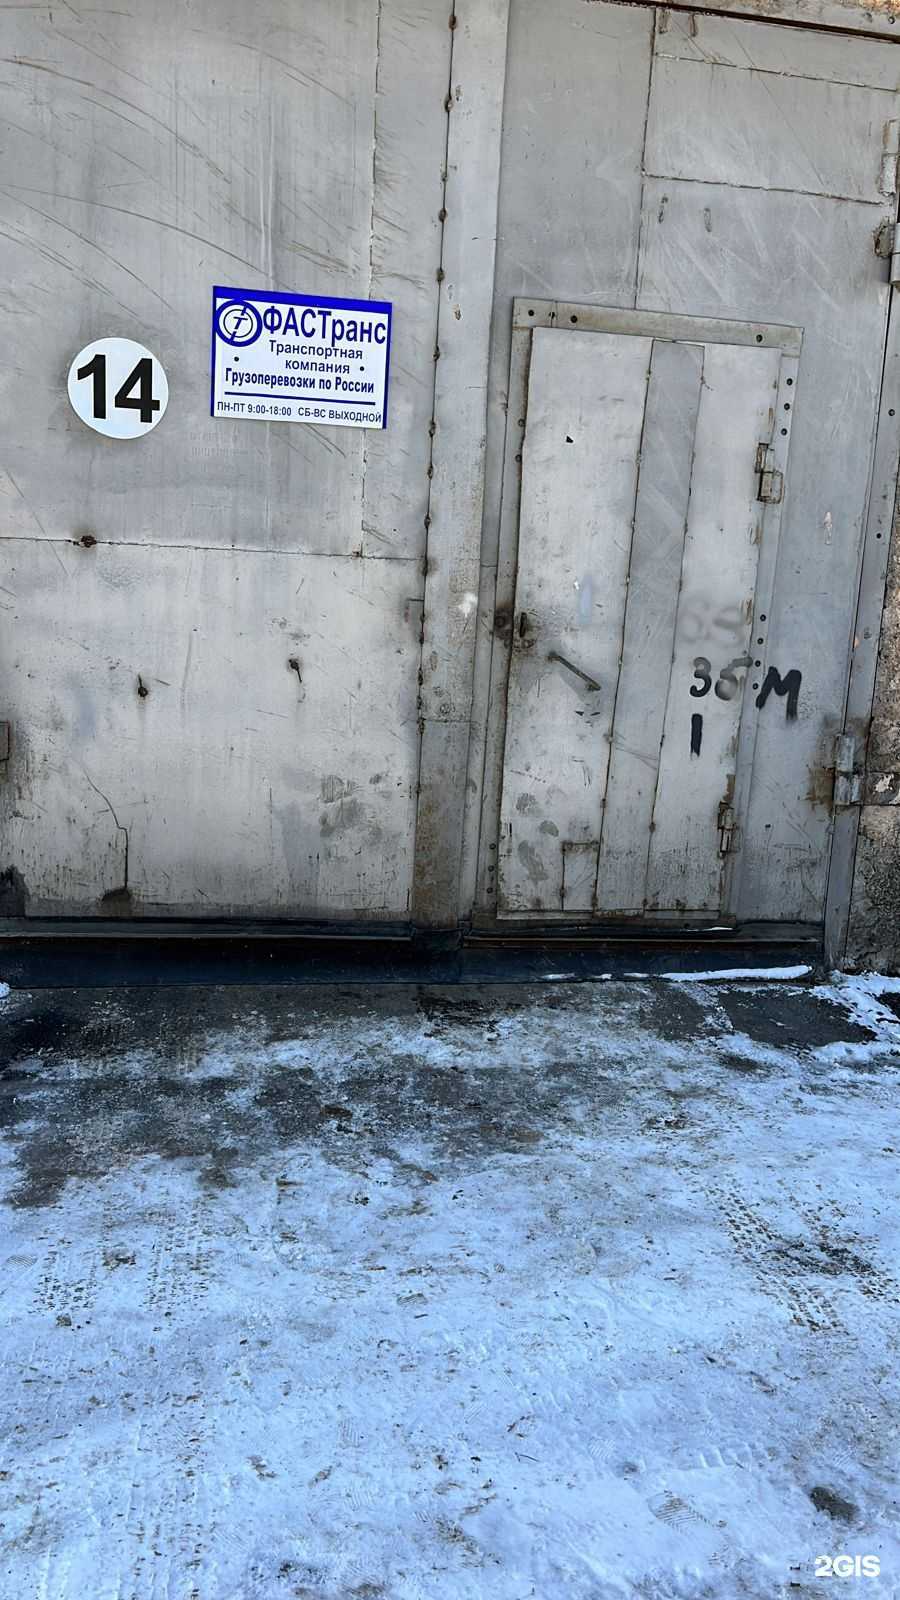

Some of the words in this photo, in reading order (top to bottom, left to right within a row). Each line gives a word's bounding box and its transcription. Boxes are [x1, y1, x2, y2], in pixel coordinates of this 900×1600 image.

[263, 305, 386, 347] ФАСТранс
[269, 339, 363, 359] Транспортная
[285, 359, 350, 374] компания
[77, 353, 160, 423] 14
[225, 367, 315, 389] Грузоперевозки
[319, 378, 331, 390] по
[335, 377, 374, 393] России
[217, 401, 246, 413] ПН-ПТ
[247, 403, 292, 416] 9:00-18:00
[298, 407, 326, 418] СБ-ВС
[328, 409, 381, 423] ВЫХОДНОЙ
